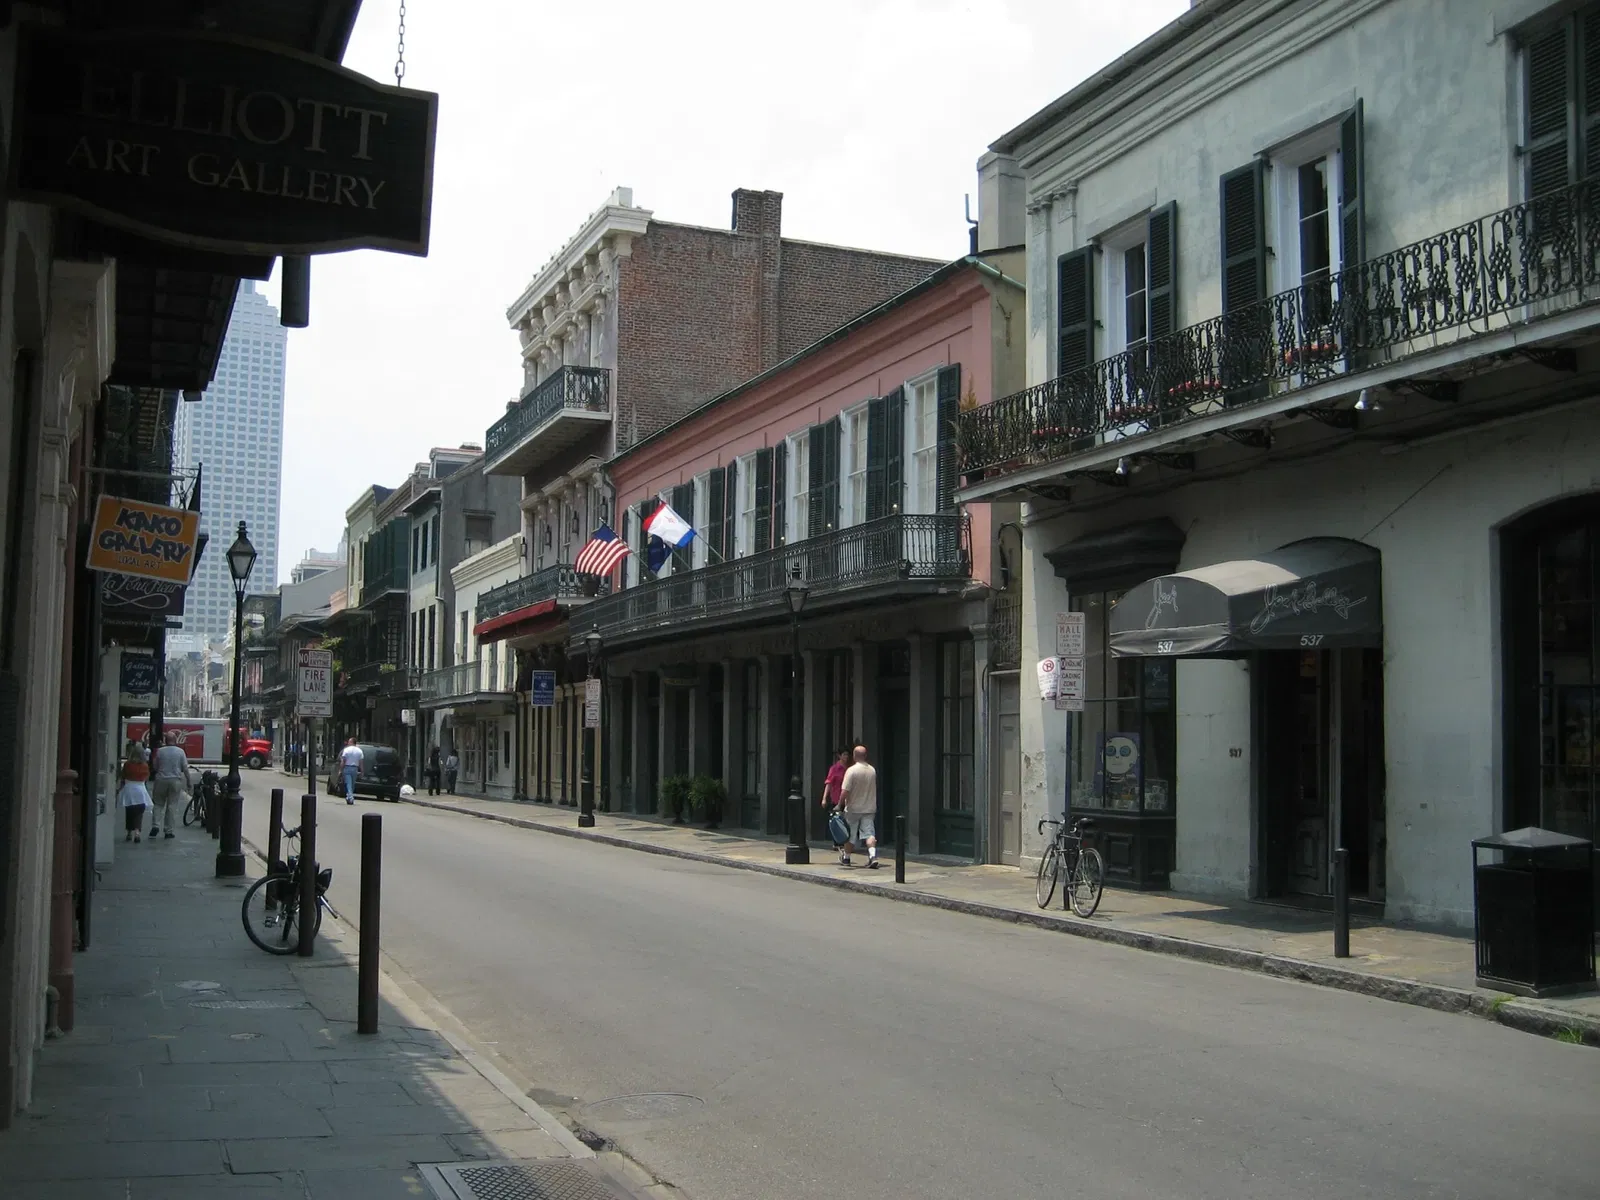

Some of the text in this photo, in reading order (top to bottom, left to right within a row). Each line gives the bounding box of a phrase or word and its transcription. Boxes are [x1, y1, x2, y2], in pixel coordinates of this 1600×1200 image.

[76, 62, 388, 161] ELLIOTT
[67, 135, 386, 210] ART GALLERY
[115, 507, 184, 537] KAKO
[98, 529, 191, 564] GALLERY
[118, 555, 164, 571] LOCAL ART
[1059, 625, 1081, 634] MALL
[1300, 634, 1324, 646] 537
[1157, 640, 1174, 653] 537
[125, 661, 155, 672] Gallery
[304, 669, 326, 681] FIRE
[127, 679, 151, 688] Light
[303, 682, 327, 693] LANE
